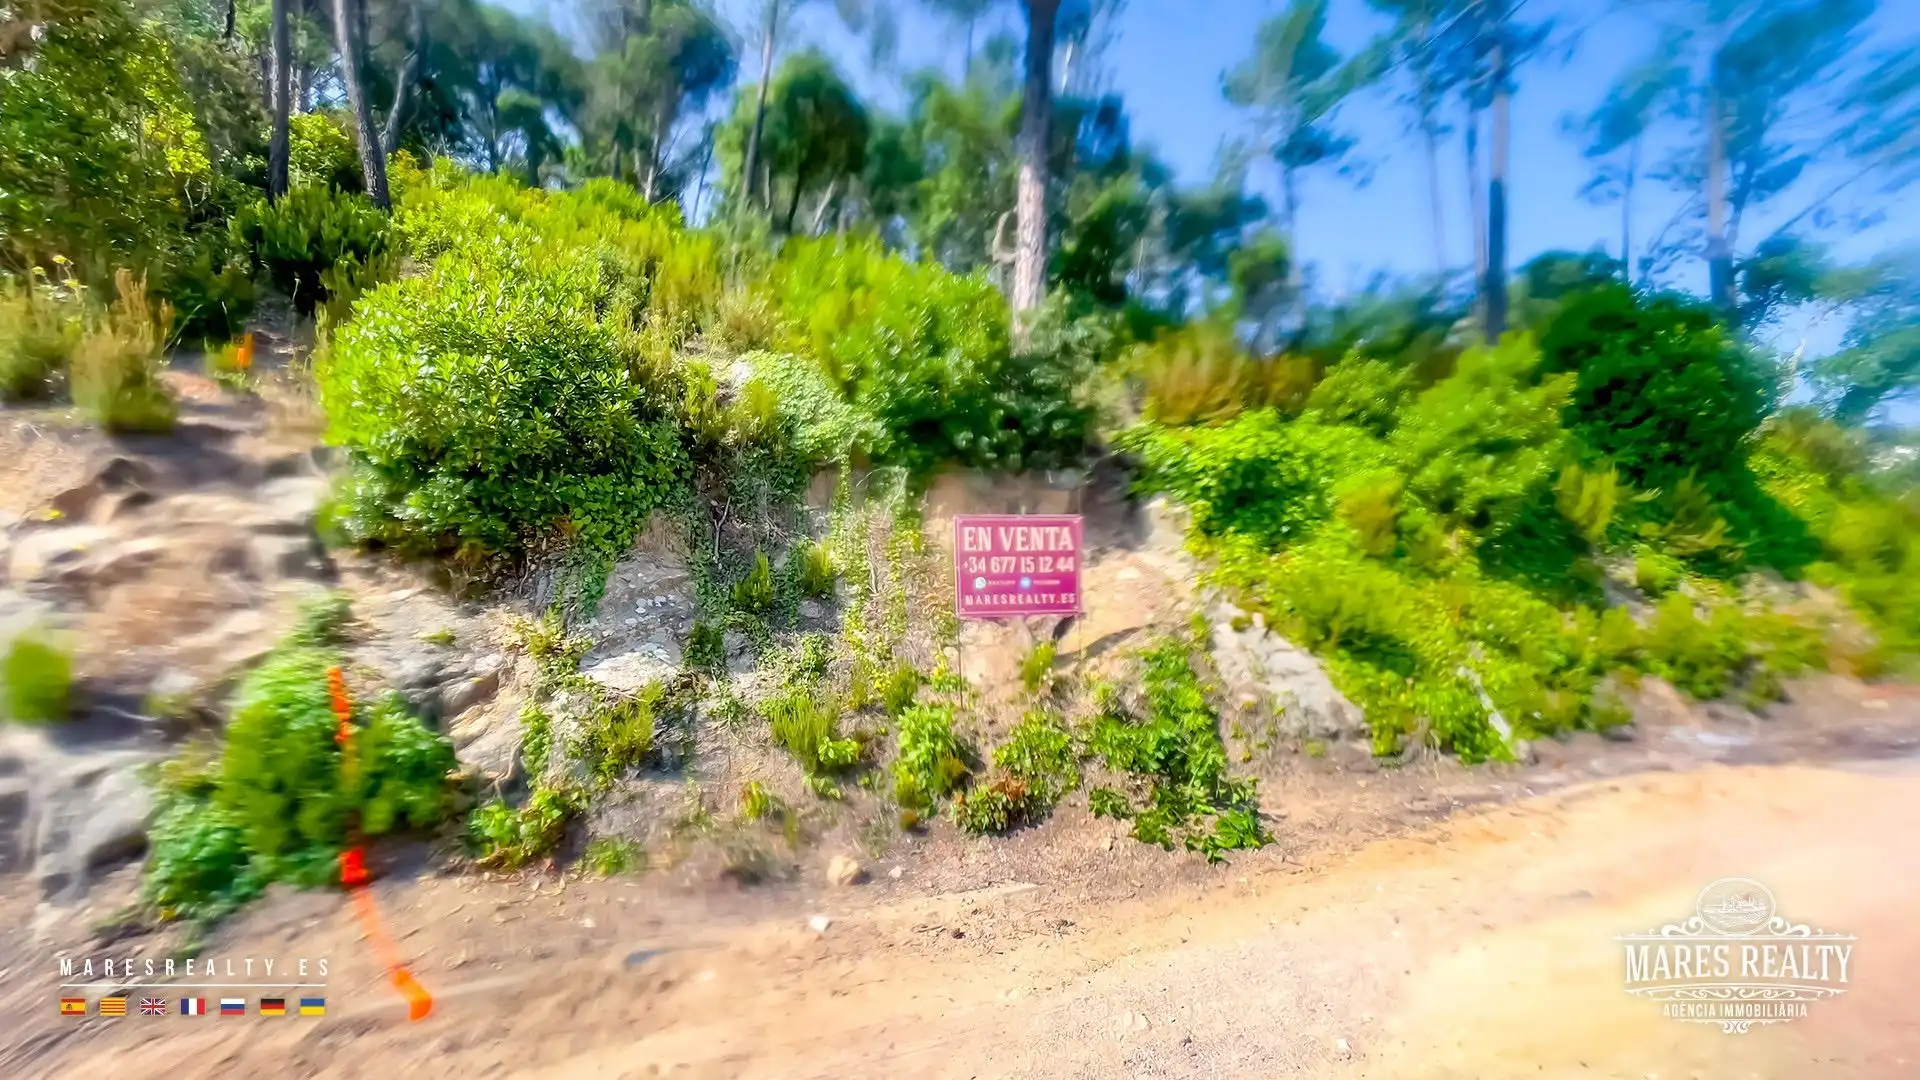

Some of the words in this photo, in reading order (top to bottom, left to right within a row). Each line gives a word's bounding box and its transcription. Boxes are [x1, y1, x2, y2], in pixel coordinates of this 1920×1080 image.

[964, 526, 992, 551] EN
[999, 526, 1074, 551] VENTA
[963, 556, 986, 573] +34
[991, 556, 1016, 573] 677
[1020, 556, 1035, 573] 15
[1039, 556, 1054, 573] 12
[1056, 556, 1075, 573] 44
[965, 593, 1076, 605] MARESREALTY.ES
